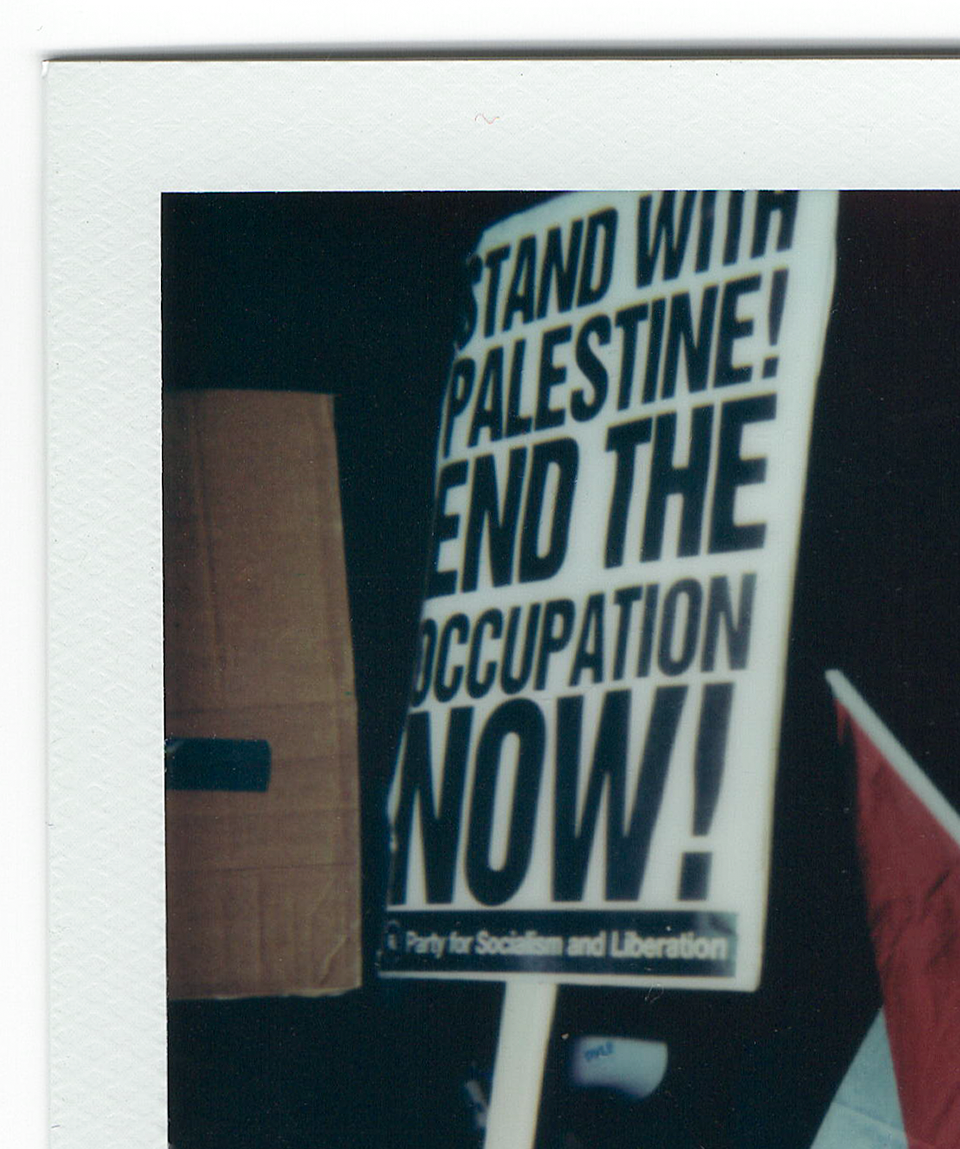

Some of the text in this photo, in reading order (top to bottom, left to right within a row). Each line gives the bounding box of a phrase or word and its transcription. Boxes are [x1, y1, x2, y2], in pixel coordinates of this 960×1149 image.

[454, 190, 799, 351] STAND WITH
[443, 268, 790, 459] PALESTINE!
[426, 393, 777, 598] END THE
[411, 574, 757, 708] OCCUPATION
[387, 682, 735, 907] NOW!
[406, 930, 445, 959] Party
[449, 930, 474, 955] for
[475, 929, 564, 956] Socialism
[568, 930, 606, 957] and
[611, 929, 728, 961] Liberation
